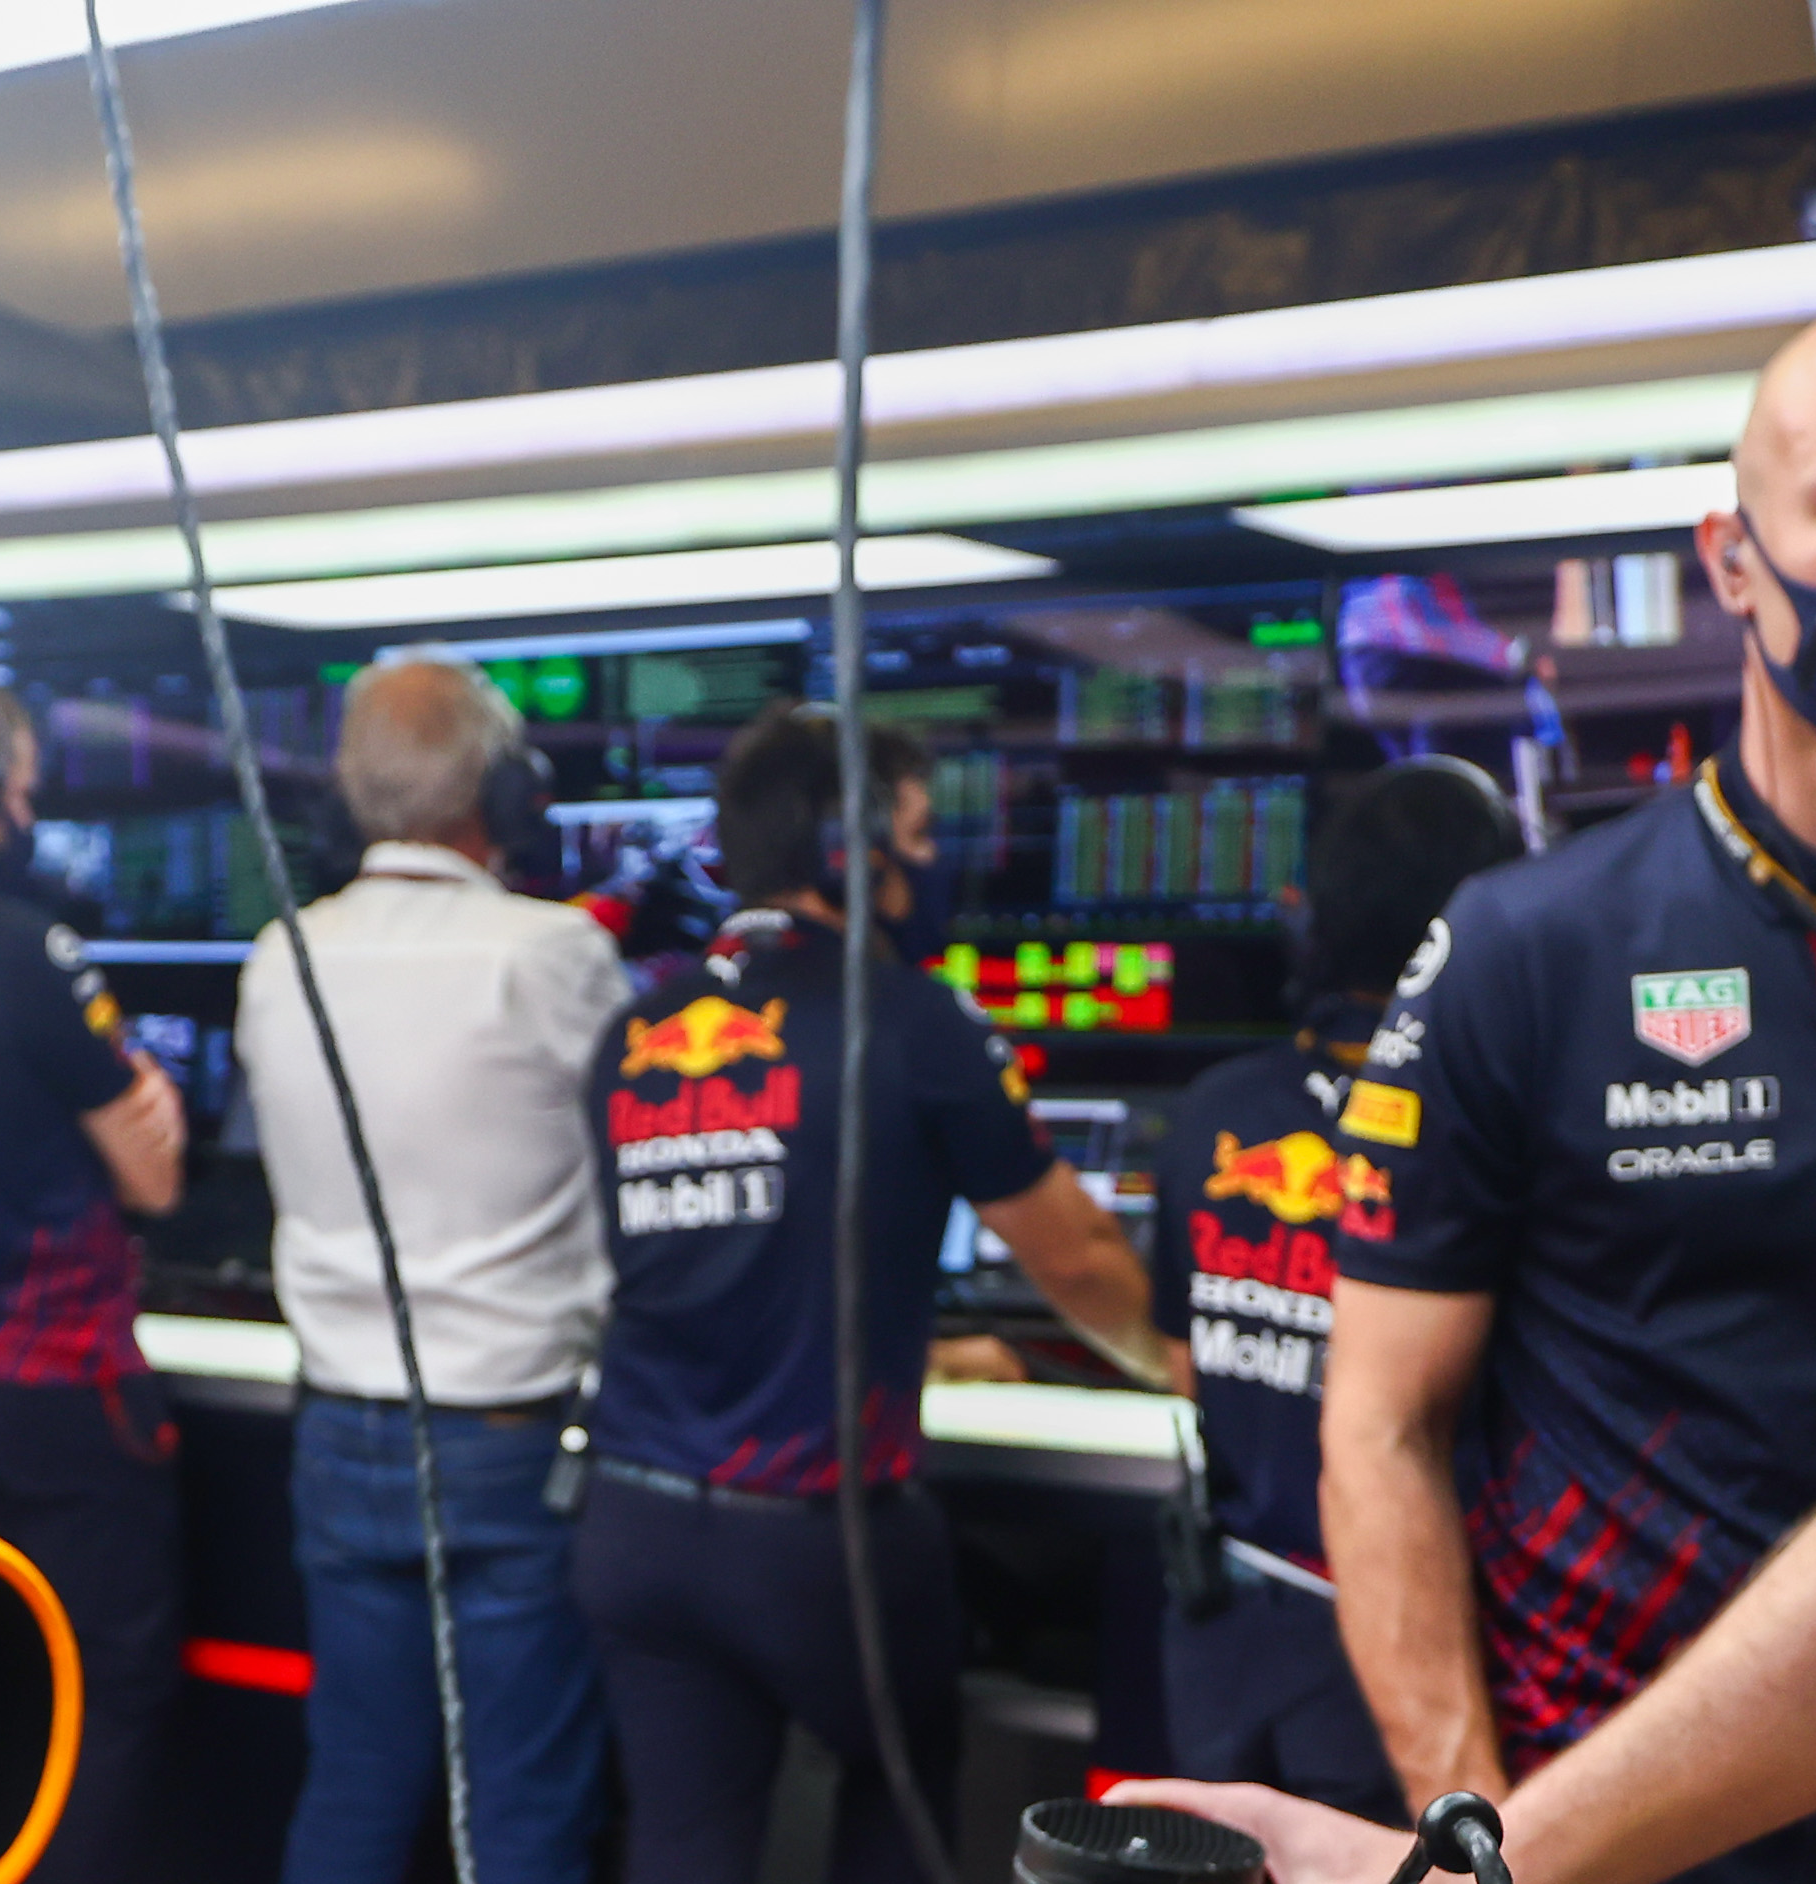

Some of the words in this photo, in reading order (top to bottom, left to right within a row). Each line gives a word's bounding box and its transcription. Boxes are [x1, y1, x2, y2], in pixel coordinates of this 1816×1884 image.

[1643, 975, 1736, 1006] TAG
[1607, 1080, 1729, 1128] Mobil
[1608, 1138, 1777, 1182] ORACLE
[1189, 1271, 1335, 1336] HOND
